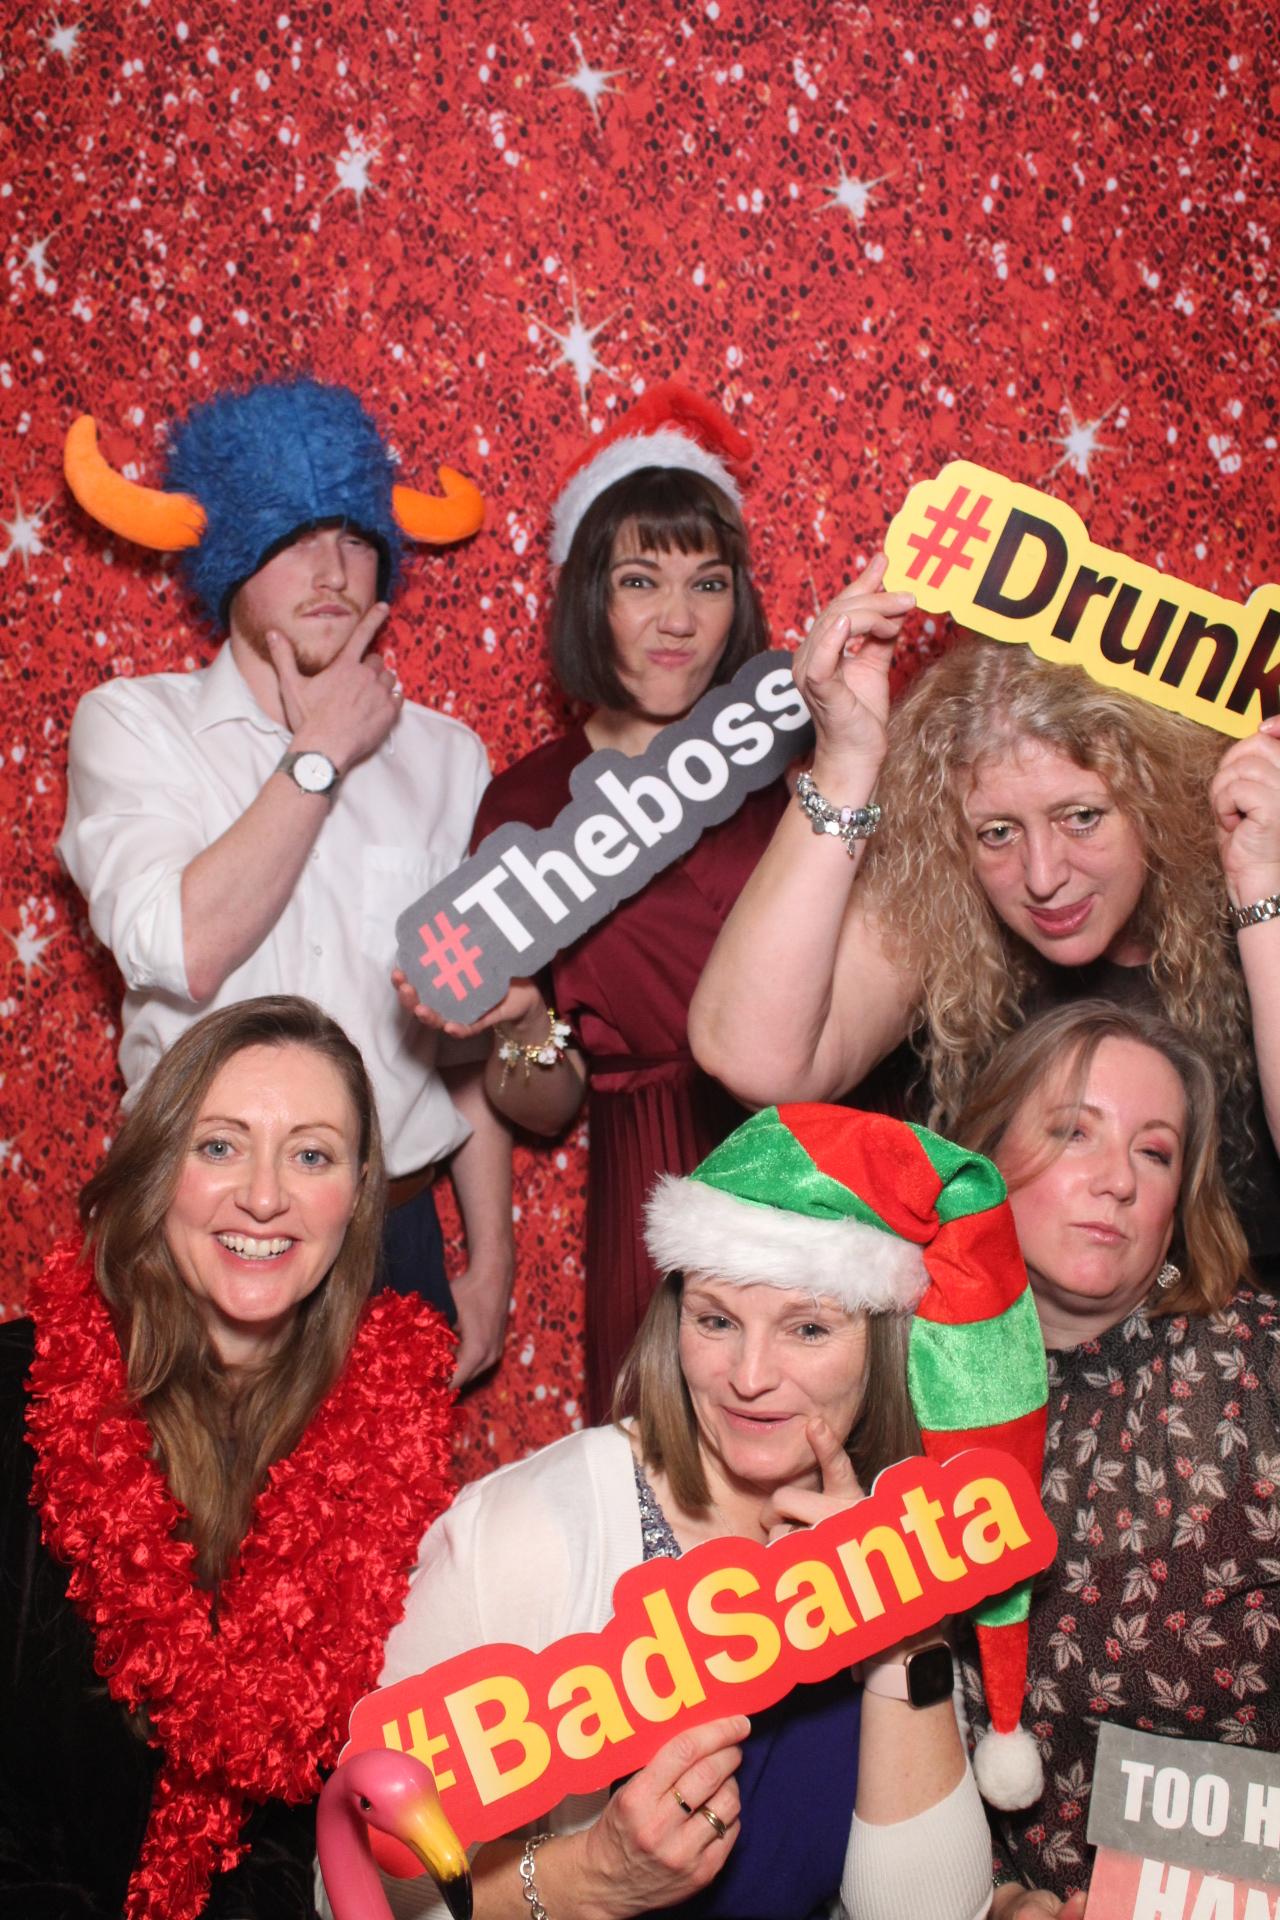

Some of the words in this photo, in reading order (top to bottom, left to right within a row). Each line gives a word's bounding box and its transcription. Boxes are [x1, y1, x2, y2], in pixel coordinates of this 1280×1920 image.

[904, 485, 1280, 722] #Drunk
[418, 667, 812, 1001] #Theboss
[1120, 1759, 1230, 1837] TOO
